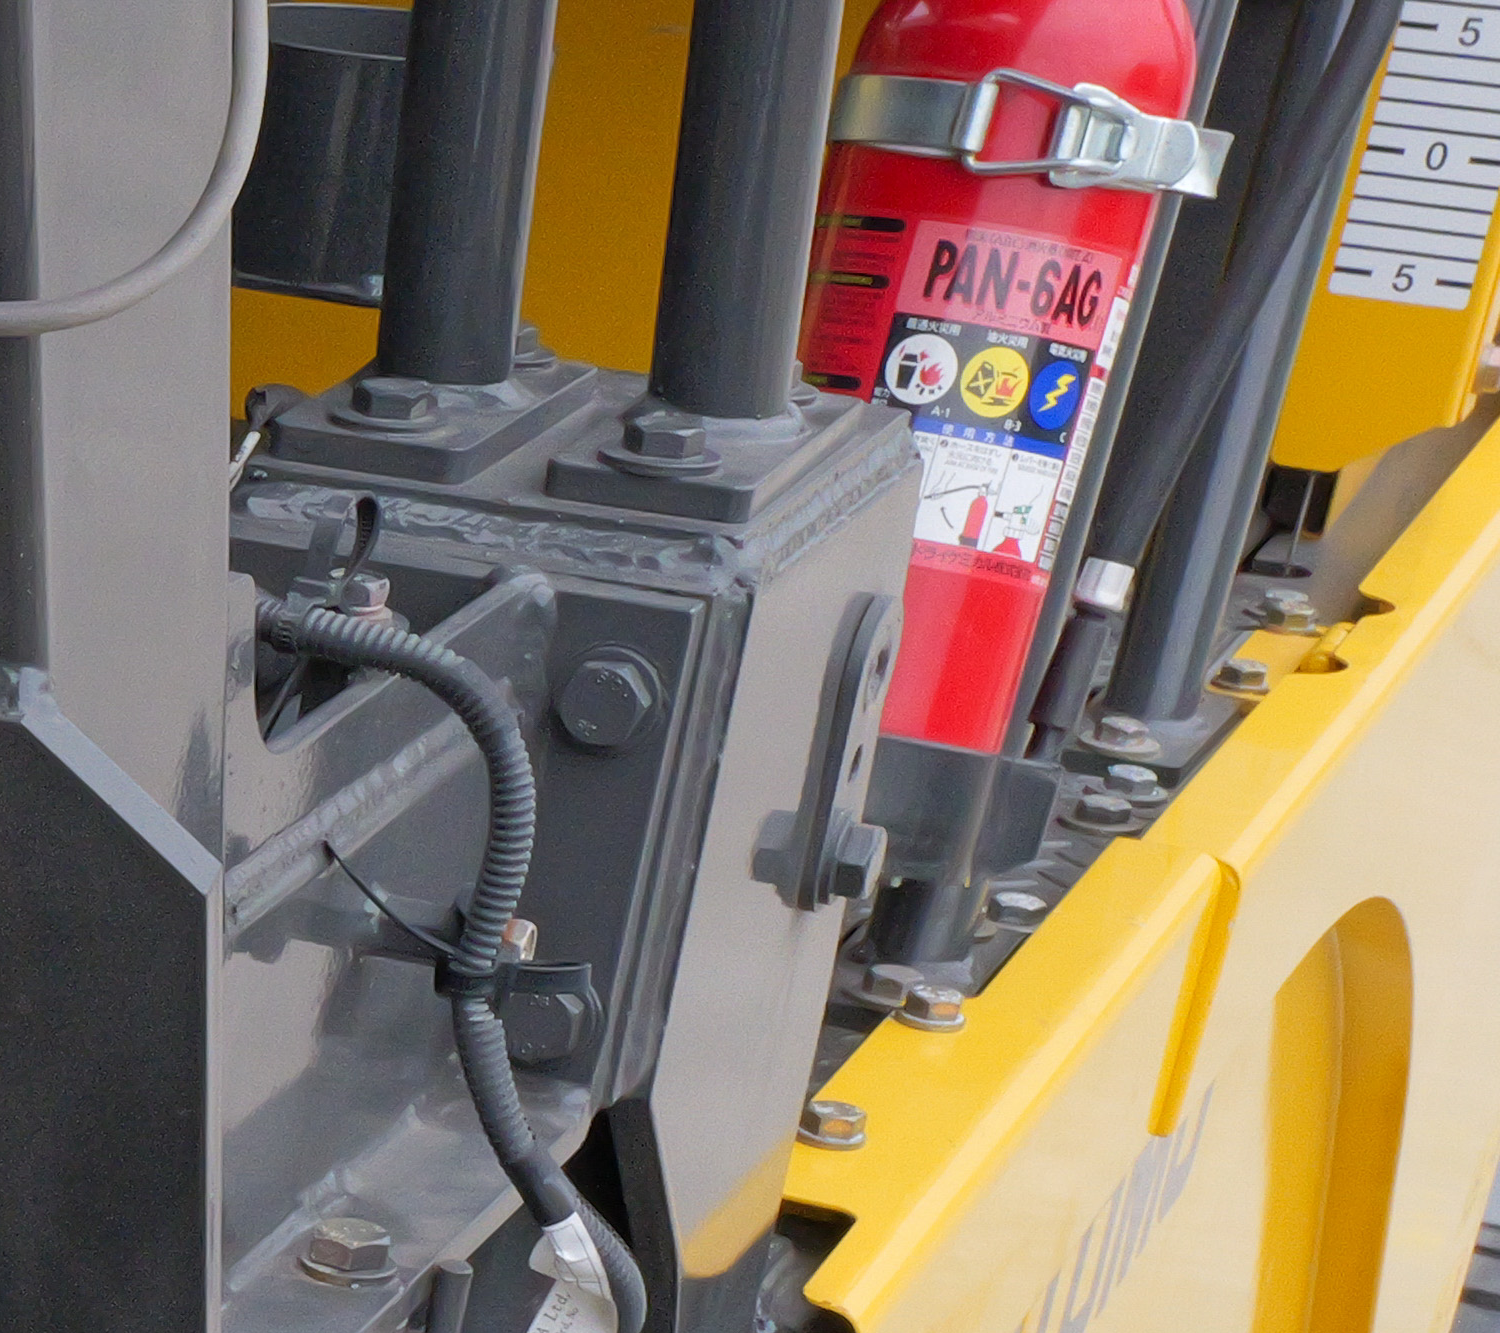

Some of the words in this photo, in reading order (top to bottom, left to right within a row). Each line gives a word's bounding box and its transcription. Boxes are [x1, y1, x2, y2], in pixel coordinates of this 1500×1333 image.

[1458, 17, 1483, 46] 5
[1426, 142, 1448, 171] 0
[923, 238, 1103, 329] PAN-6AG
[1392, 264, 1416, 292] 5
